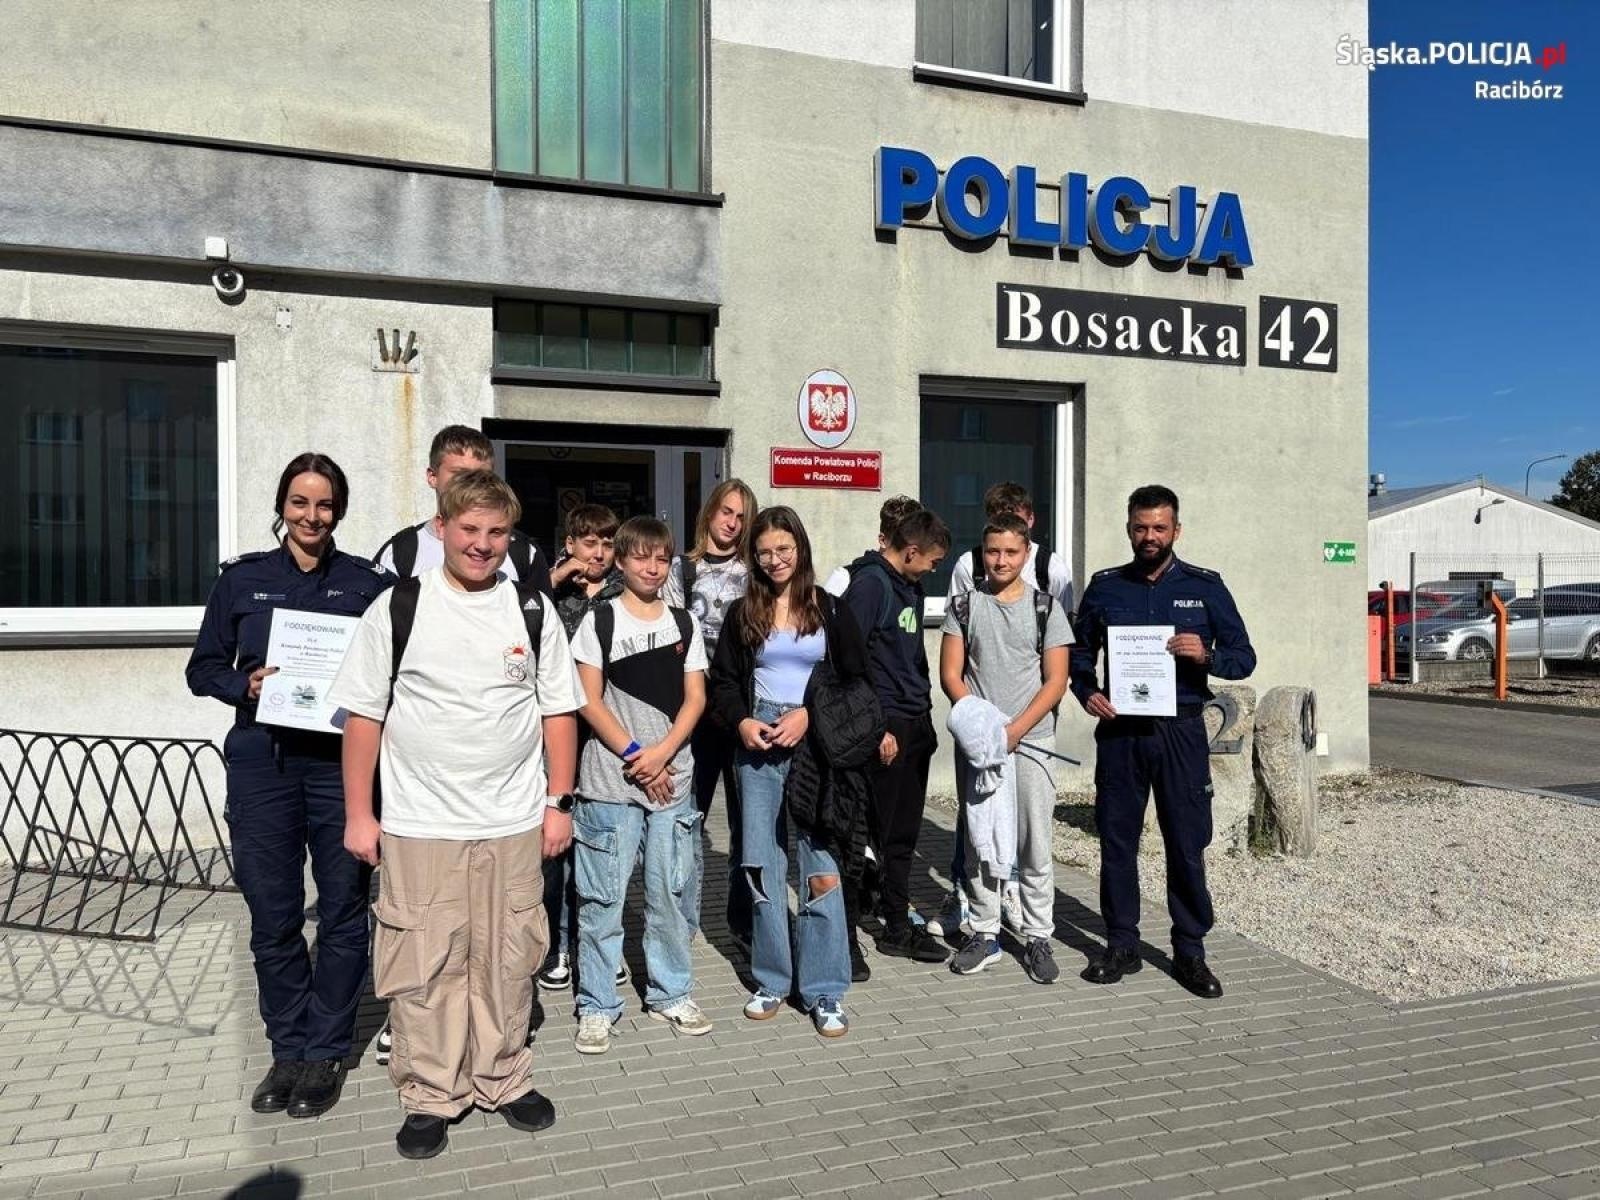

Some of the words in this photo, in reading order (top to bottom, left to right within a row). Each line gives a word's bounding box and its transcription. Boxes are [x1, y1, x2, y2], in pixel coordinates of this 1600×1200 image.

[875, 146, 1254, 268] POLICJA
[1003, 290, 1241, 359] Bosacka
[1264, 304, 1333, 365] 42
[774, 455, 813, 466] Komenda
[814, 456, 856, 468] Powiatowa
[812, 472, 853, 482] Raciborzu
[1173, 600, 1204, 608] POLICJA
